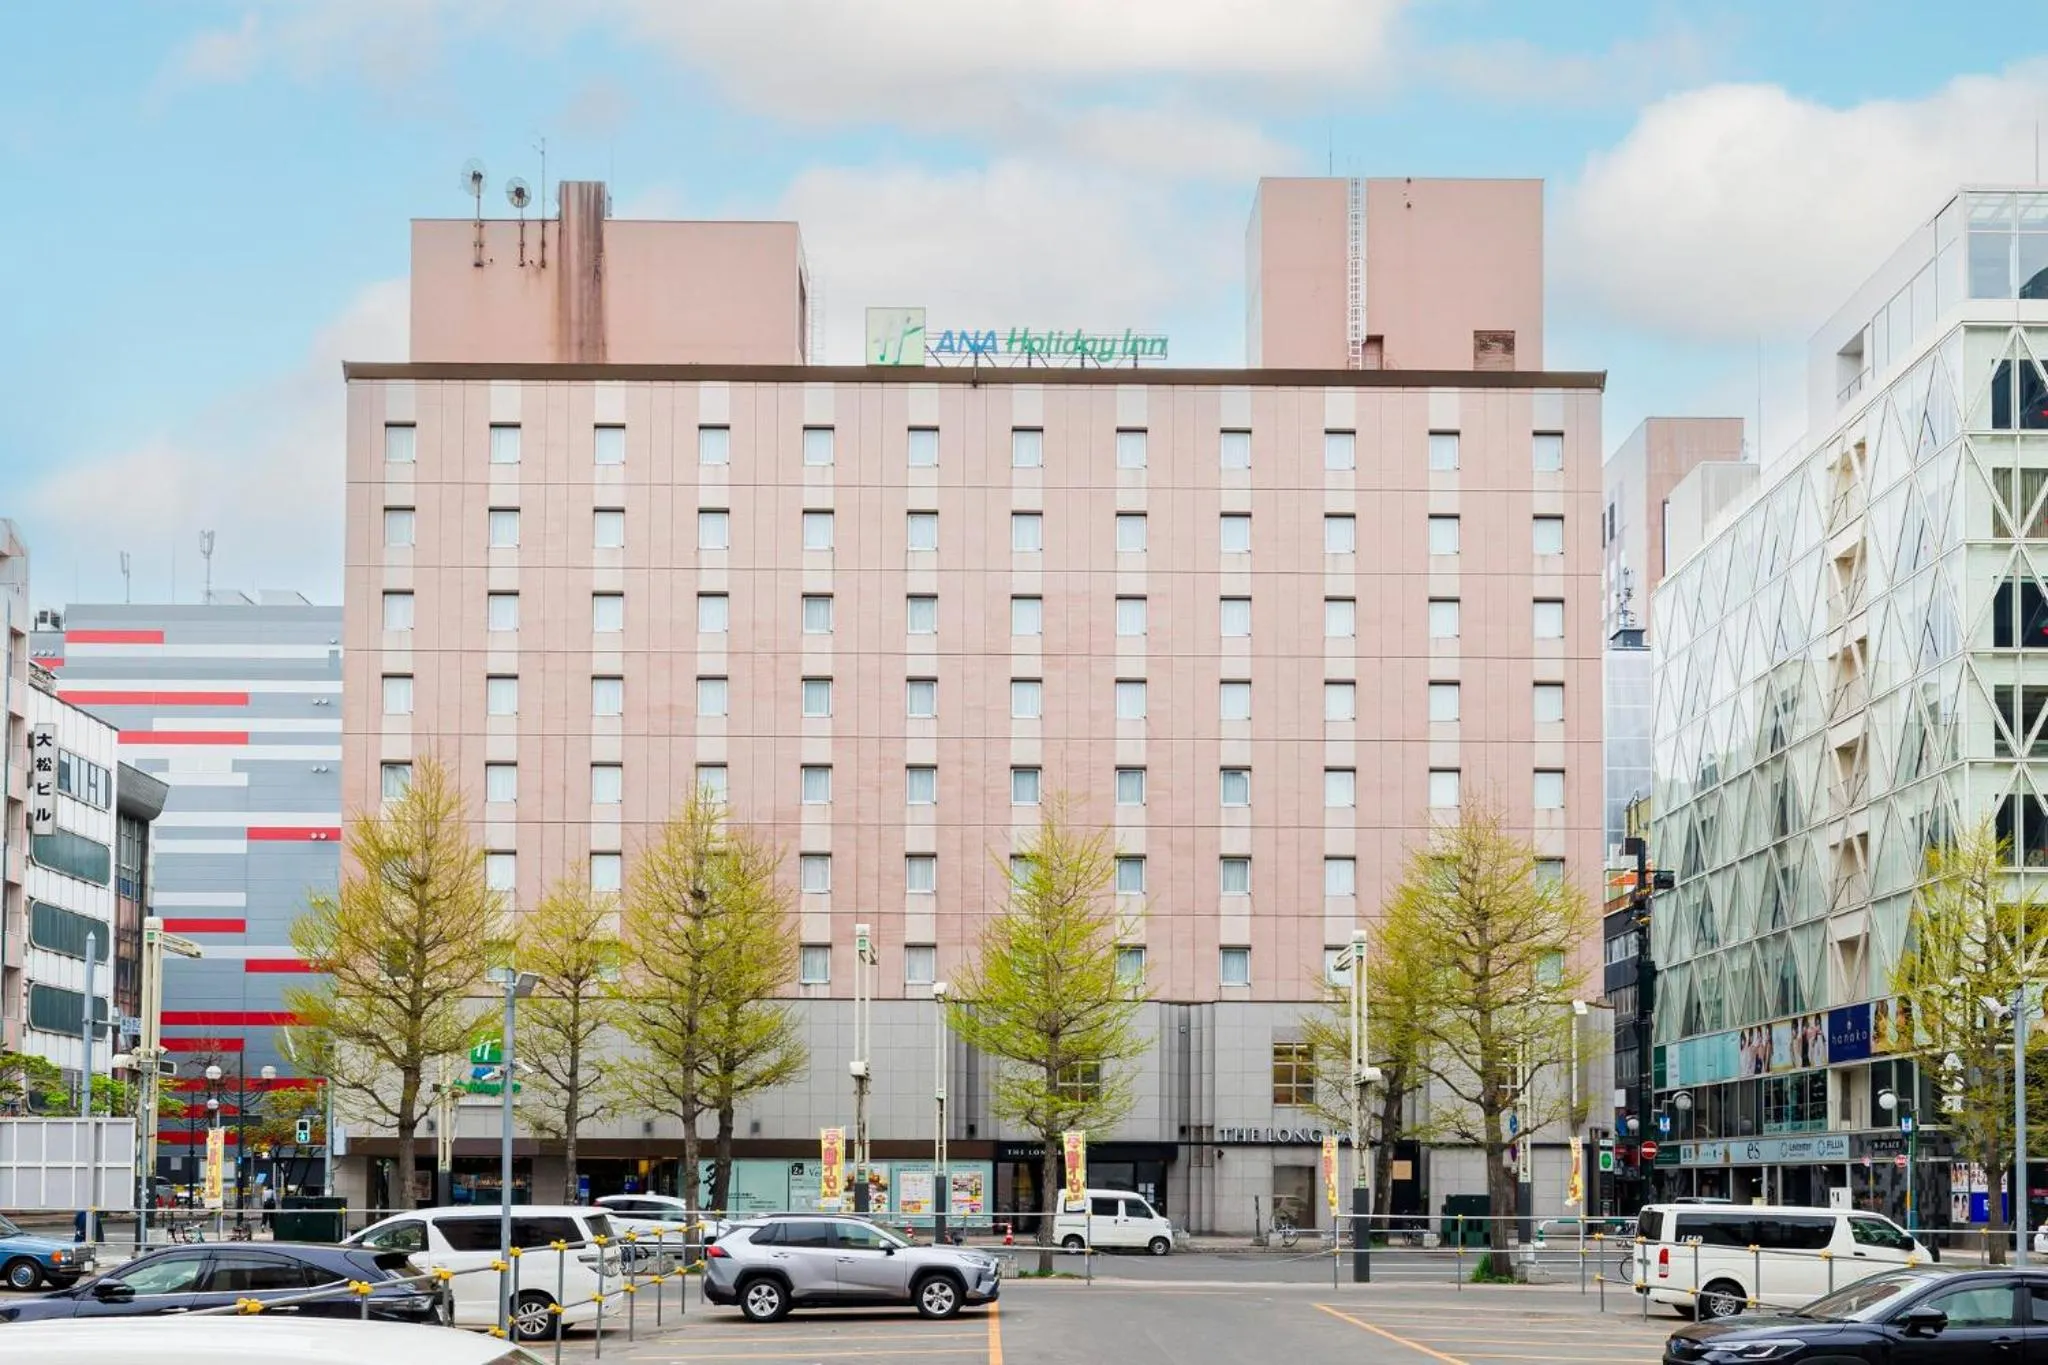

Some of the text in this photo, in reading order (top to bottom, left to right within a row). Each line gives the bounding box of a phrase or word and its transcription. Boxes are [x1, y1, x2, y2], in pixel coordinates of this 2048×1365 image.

[935, 327, 1168, 362] ANA Holiday Inn
[36, 732, 53, 821] 大松ビル
[1219, 1127, 1259, 1142] THE
[1267, 1127, 1323, 1142] LONG
[1008, 1148, 1025, 1156] THE
